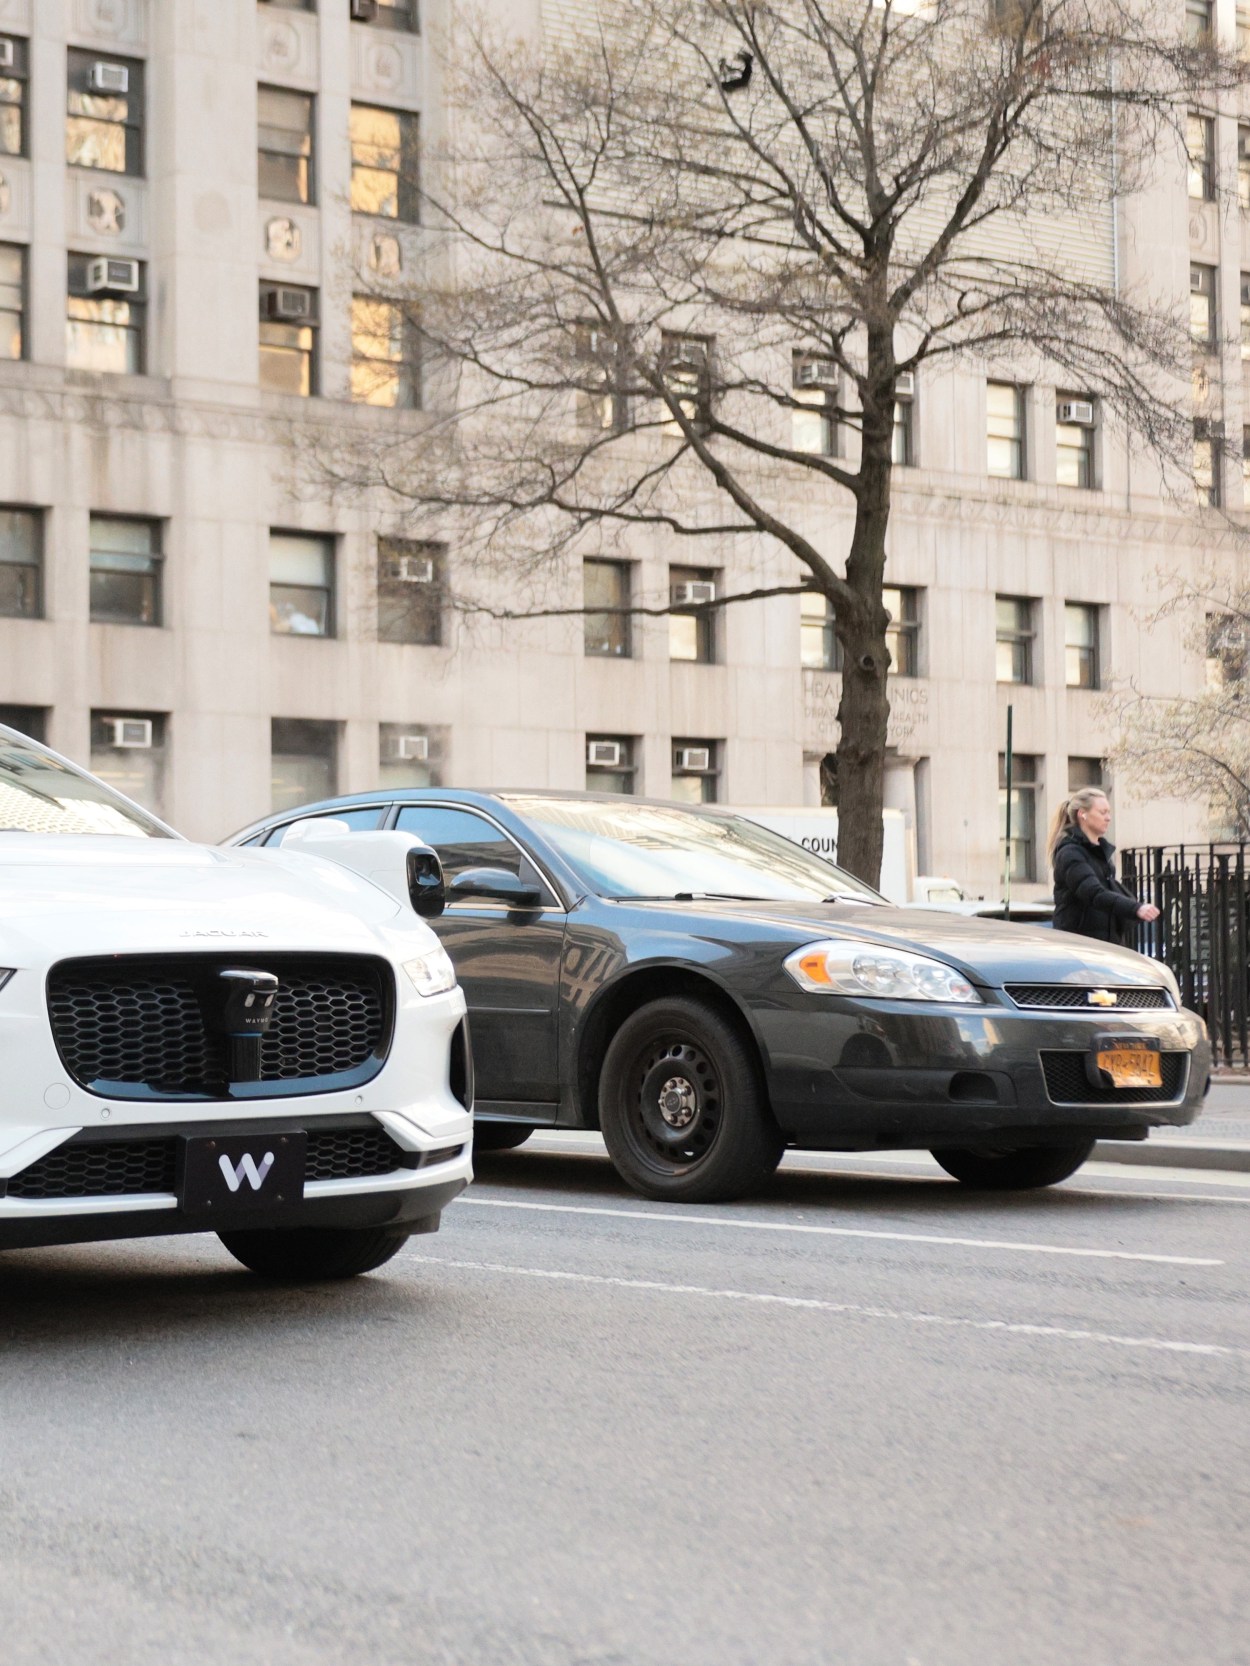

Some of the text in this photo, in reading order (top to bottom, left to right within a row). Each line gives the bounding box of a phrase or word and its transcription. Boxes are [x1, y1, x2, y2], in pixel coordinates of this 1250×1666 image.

[804, 681, 929, 705] HEAL INICS
[892, 711, 929, 724] HEALTH
[179, 930, 270, 938] JAGUAR
[218, 1151, 275, 1193] W
